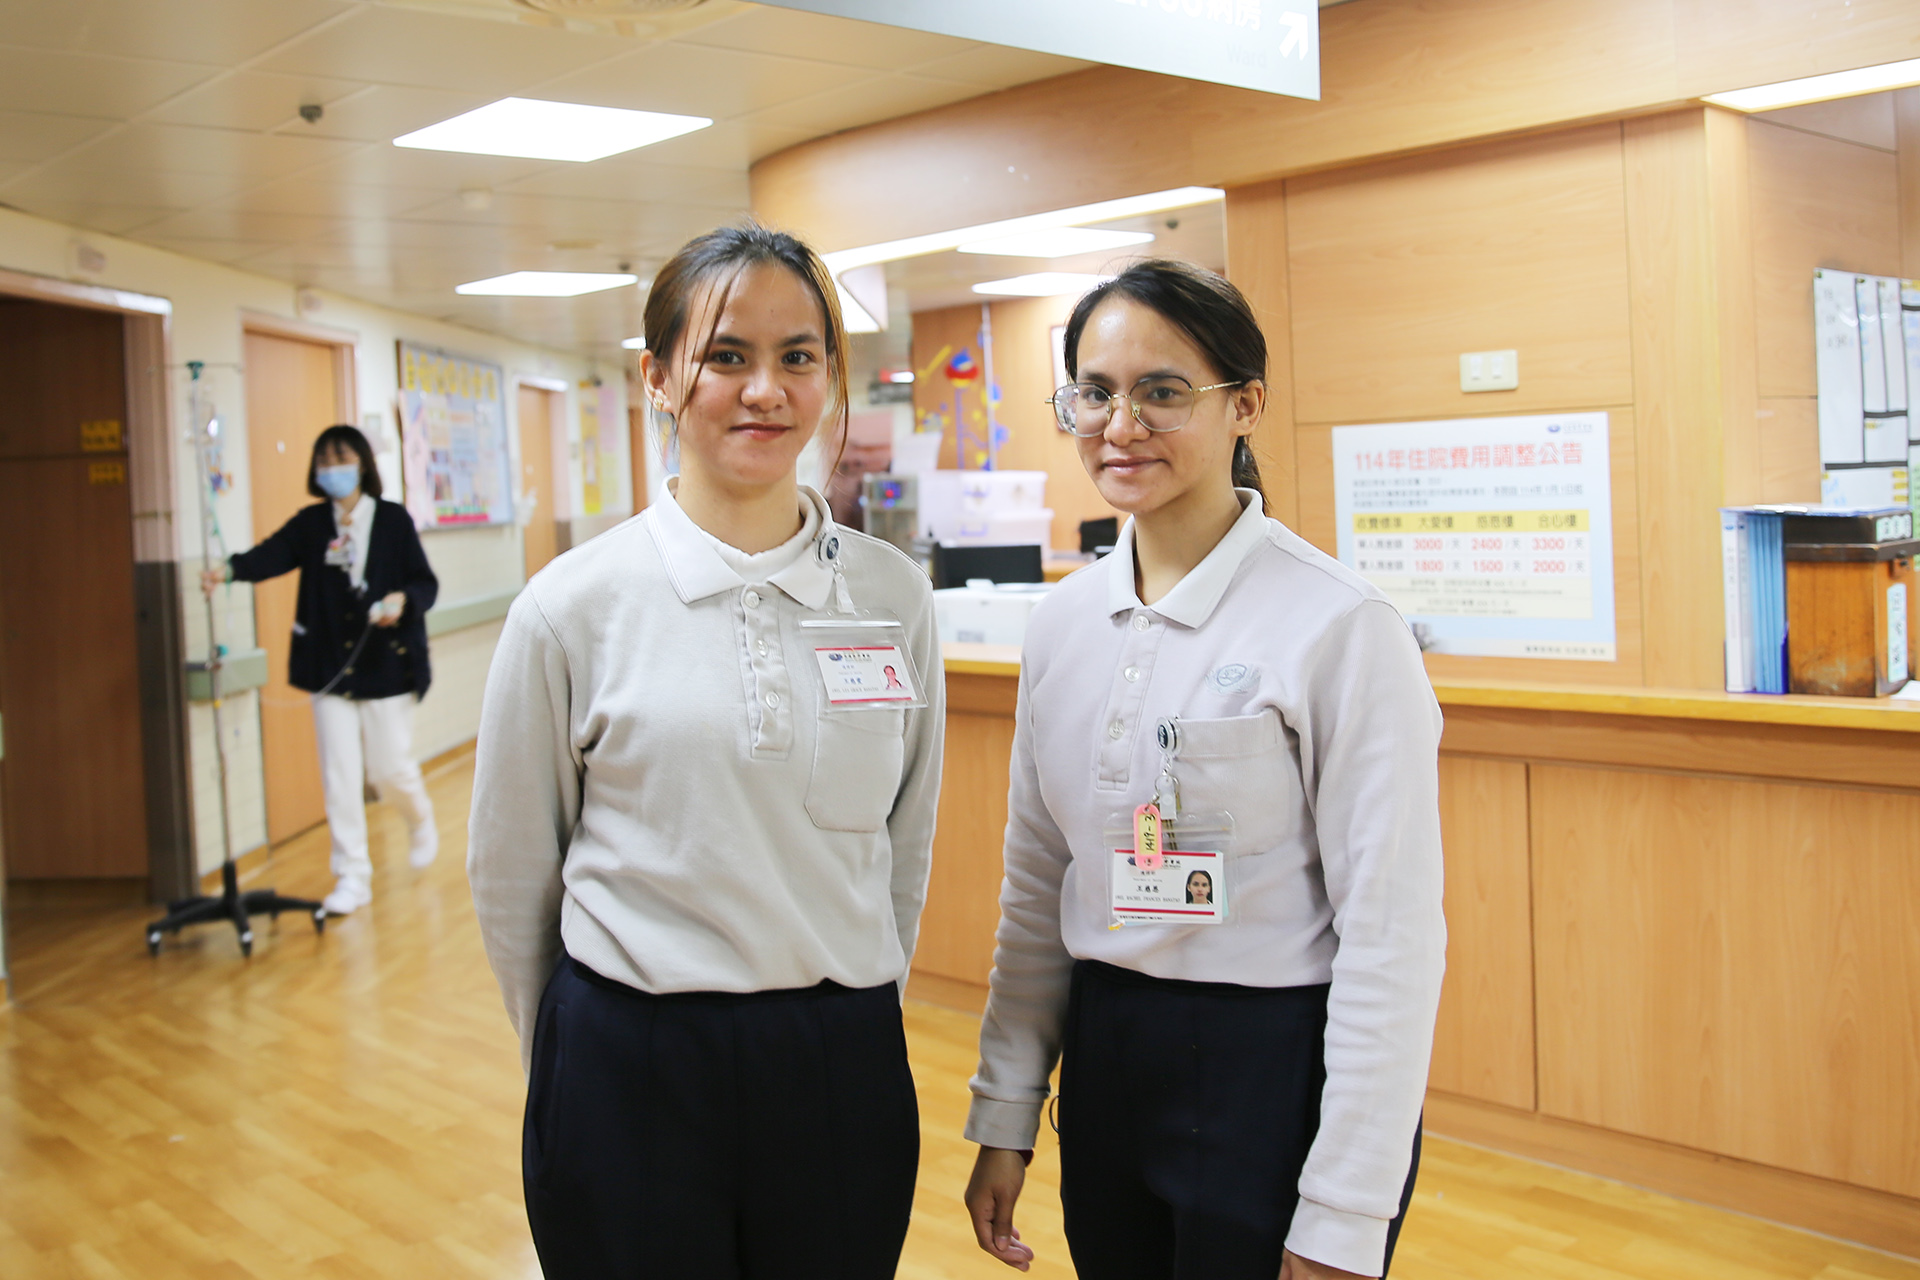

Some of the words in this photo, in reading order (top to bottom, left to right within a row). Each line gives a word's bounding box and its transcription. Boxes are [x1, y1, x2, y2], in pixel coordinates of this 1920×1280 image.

[1355, 442, 1583, 471] 114年住院費用調整公告
